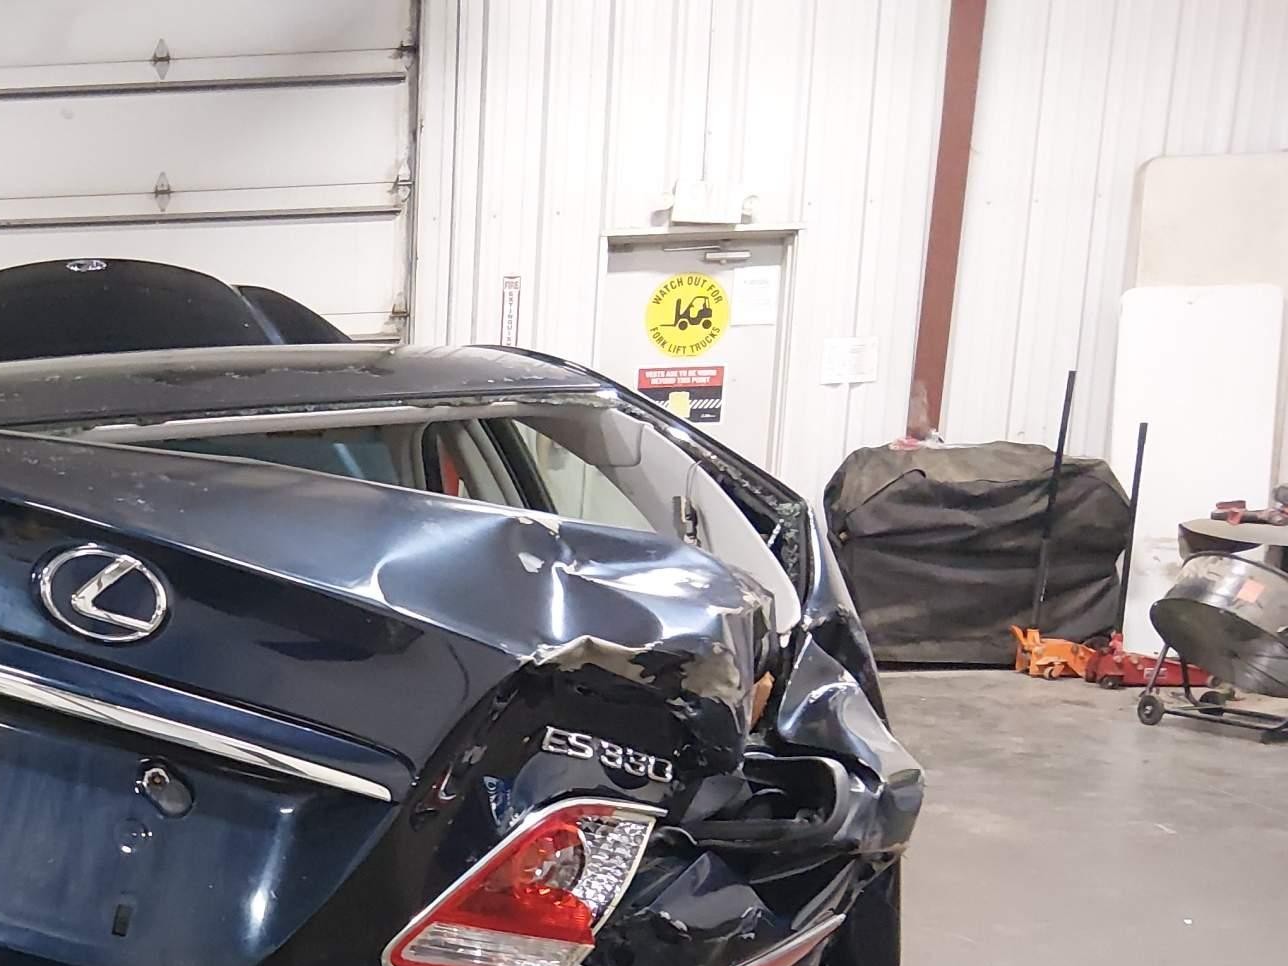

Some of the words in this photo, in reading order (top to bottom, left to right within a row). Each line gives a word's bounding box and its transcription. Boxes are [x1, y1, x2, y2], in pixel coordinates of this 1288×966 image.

[652, 277, 683, 305] WATCH
[687, 276, 707, 288] OUT
[706, 284, 724, 304] FOR
[650, 326, 667, 348] FORK
[668, 343, 687, 354] LIFT
[689, 326, 720, 353] TRUCKS
[541, 725, 594, 760] ES
[599, 739, 674, 783] 330
